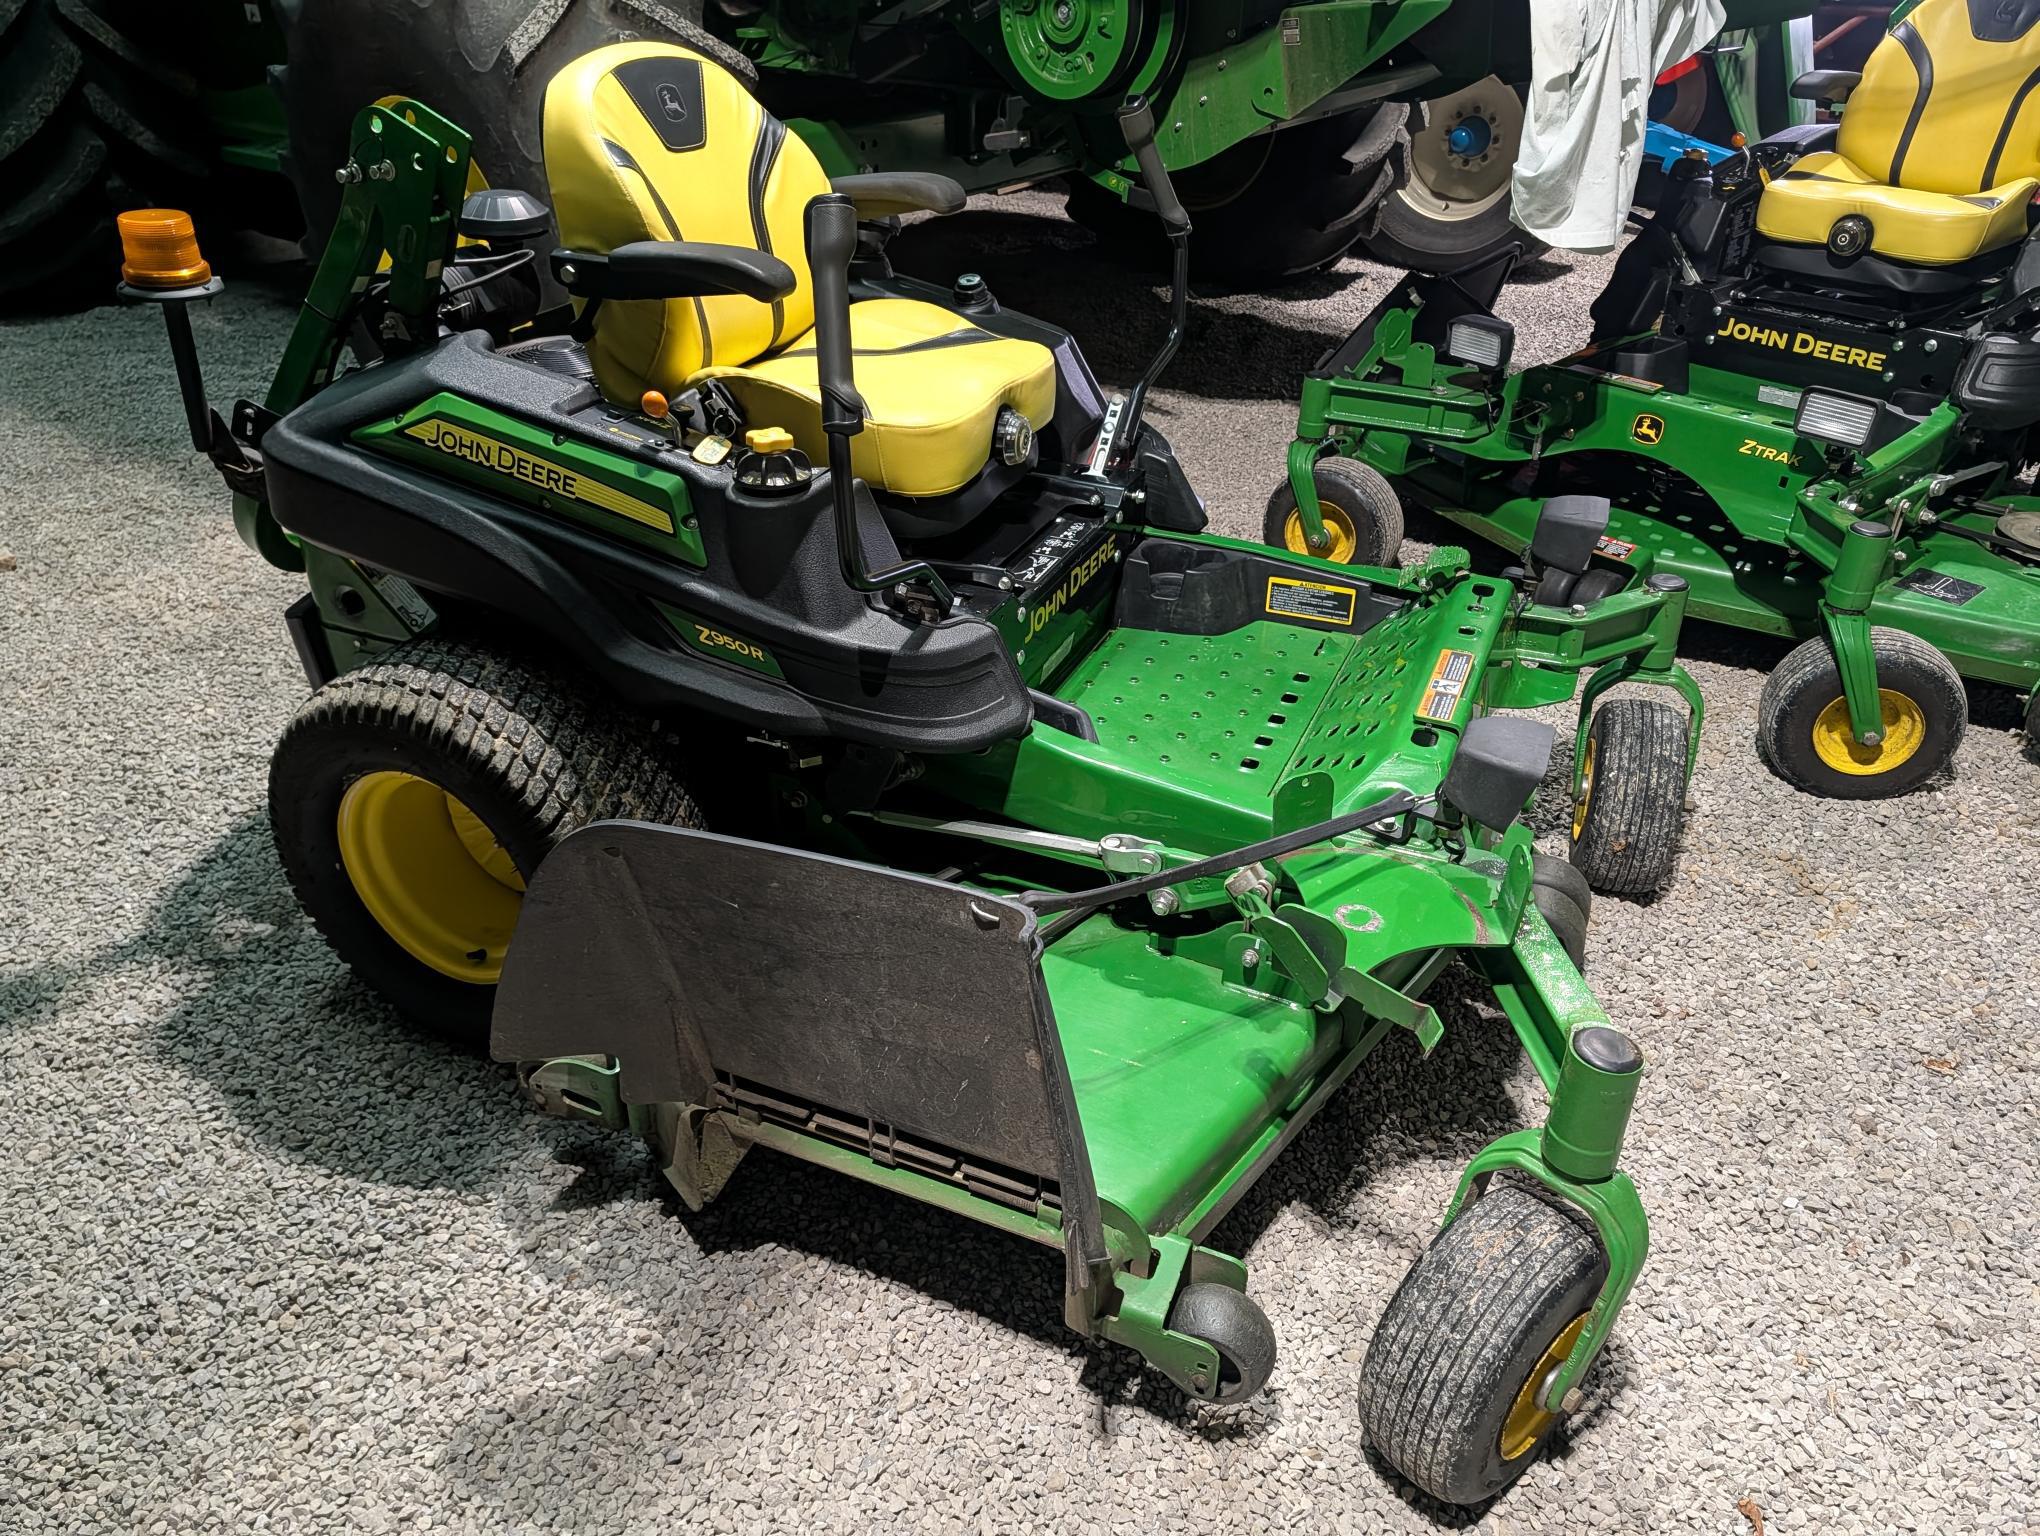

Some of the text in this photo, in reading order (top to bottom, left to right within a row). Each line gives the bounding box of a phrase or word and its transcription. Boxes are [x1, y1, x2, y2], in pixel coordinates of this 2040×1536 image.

[1717, 317, 1789, 350] JOHN
[1793, 332, 1887, 372] DEERE
[427, 422, 577, 497] JOHN DEERE
[1738, 439, 1803, 467] ZTRAK
[1025, 582, 1067, 644] JOHN
[1070, 533, 1116, 598] DEERE
